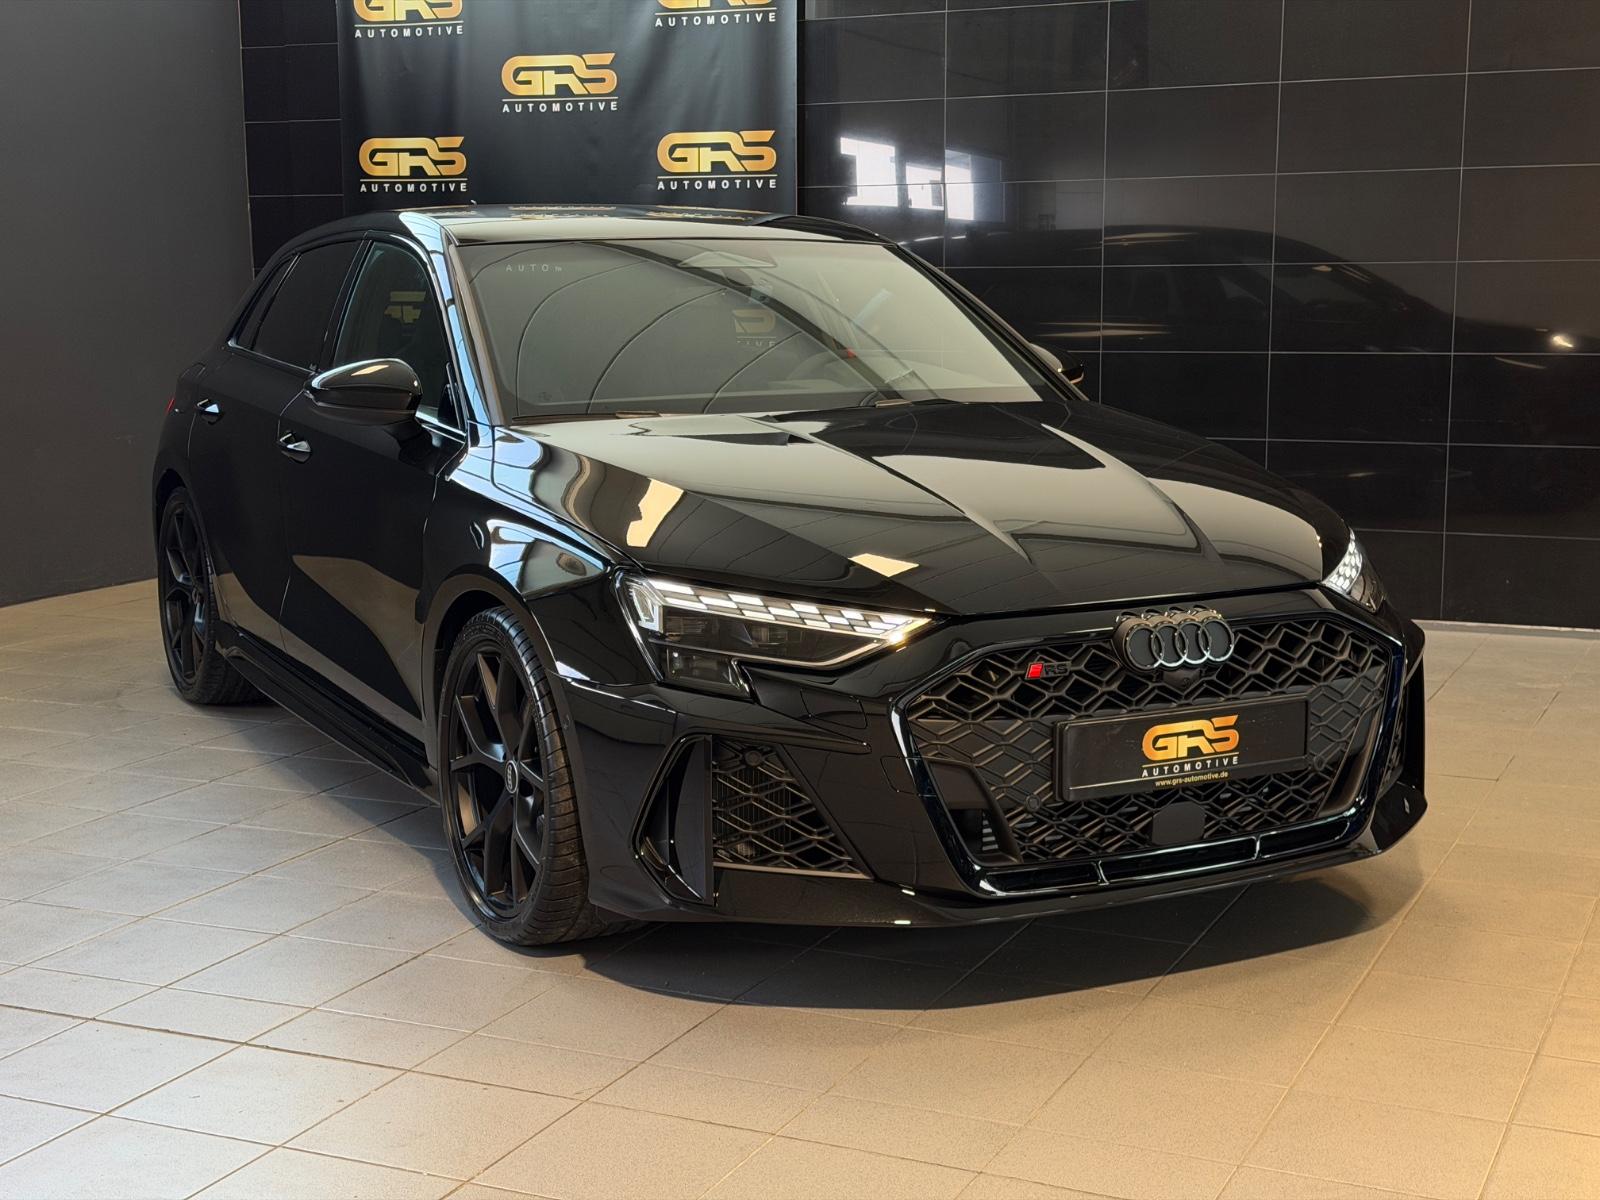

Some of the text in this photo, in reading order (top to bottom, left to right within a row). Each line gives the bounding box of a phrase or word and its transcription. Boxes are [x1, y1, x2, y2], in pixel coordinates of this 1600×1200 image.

[655, 12, 777, 27] AUTOMOTIVE
[354, 25, 463, 38] AUTOMOTIVE
[501, 52, 618, 96] GRS
[502, 101, 618, 113] AUTOMOTIVE
[358, 136, 467, 176] GRS
[656, 130, 777, 173] GRS
[359, 182, 467, 193] AUTOMOTIVE
[657, 179, 777, 190] AUTOMOTIVE
[1142, 714, 1240, 761] GRS
[1141, 756, 1239, 778] AUTOMOTIVE
[1155, 771, 1229, 787] www.grs-automotive.de
